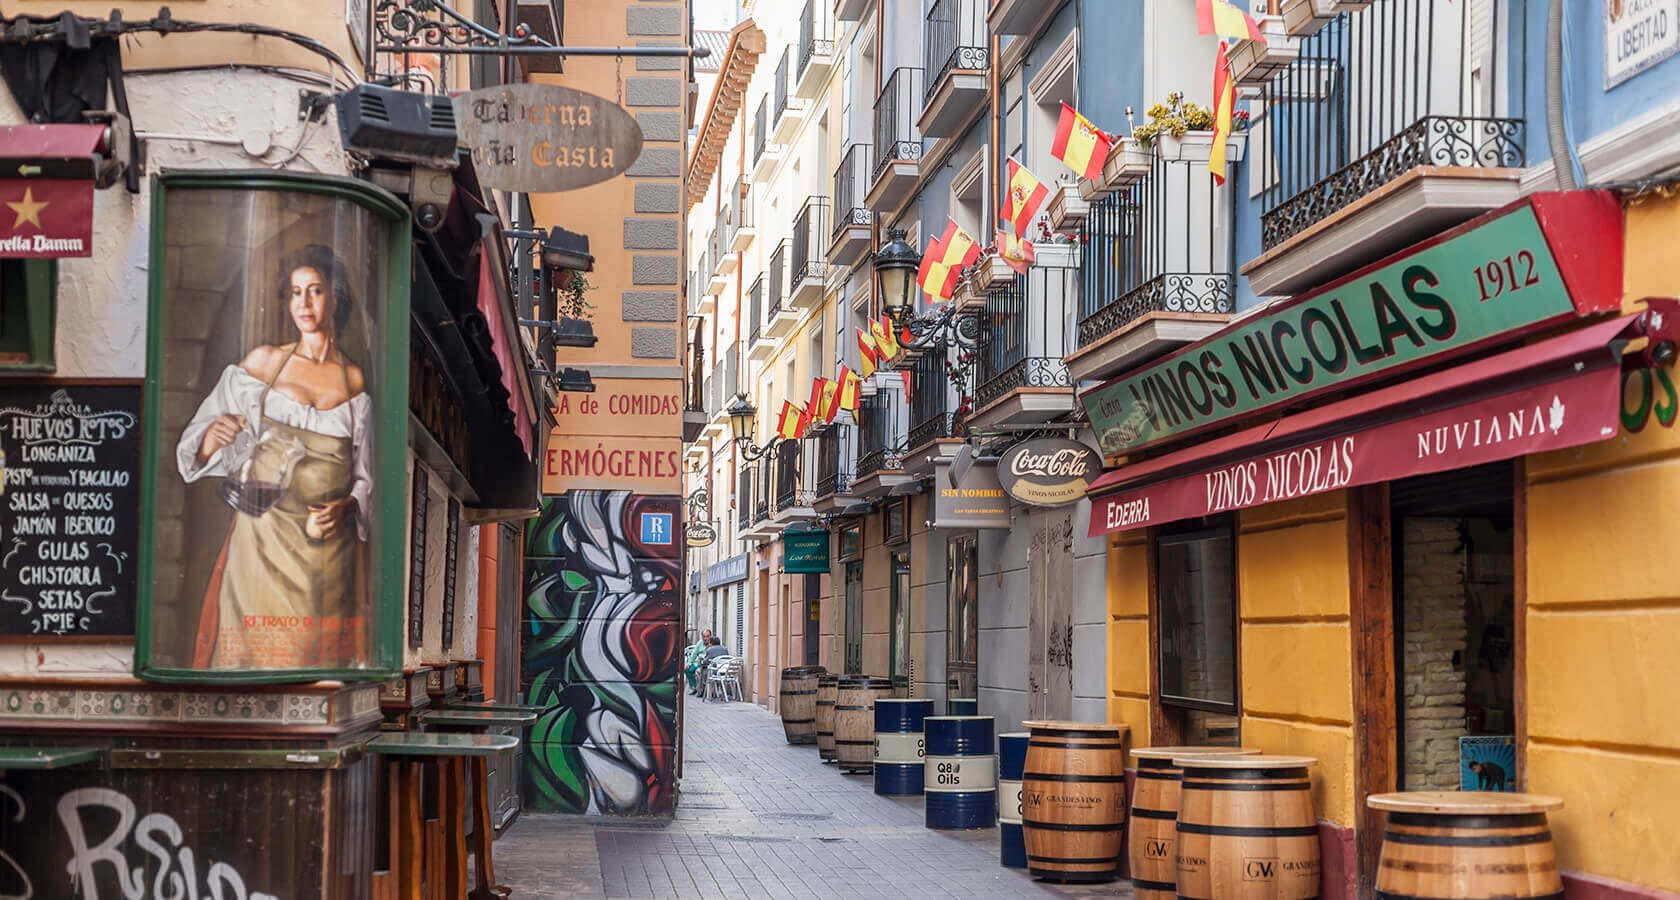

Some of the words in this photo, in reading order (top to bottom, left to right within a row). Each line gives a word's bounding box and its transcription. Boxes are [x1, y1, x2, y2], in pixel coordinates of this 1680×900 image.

[1617, 9, 1668, 63] LIBERTAD
[531, 141, 616, 168] Casta
[32, 234, 84, 252] Damm
[1472, 249, 1541, 302] 1912
[1128, 350, 1238, 432] VINOS
[1228, 263, 1457, 401] NICOLAS
[580, 394, 599, 415] de
[608, 394, 680, 416] COMIDAS
[11, 416, 75, 440] HUEVOS
[1416, 405, 1547, 459] NUVIANA
[21, 445, 96, 463] LONGANIZA
[546, 443, 678, 478] ERMÓGENES
[79, 469, 130, 487] BACALAO
[1205, 461, 1257, 513] VINOS
[1263, 435, 1355, 502] NICOLAS
[9, 492, 50, 511] SALSA
[63, 491, 114, 511] QUESOS
[941, 488, 959, 497] SIN
[12, 512, 57, 535] JAMÓN
[64, 510, 116, 536] IBÉRICO
[651, 516, 663, 534] R
[38, 540, 90, 561] GULAS
[19, 565, 102, 586] CHISTORRA
[37, 589, 84, 611] SETAS
[243, 615, 300, 630] RETRATO
[937, 763, 952, 773] Q8
[937, 774, 960, 785] Oils
